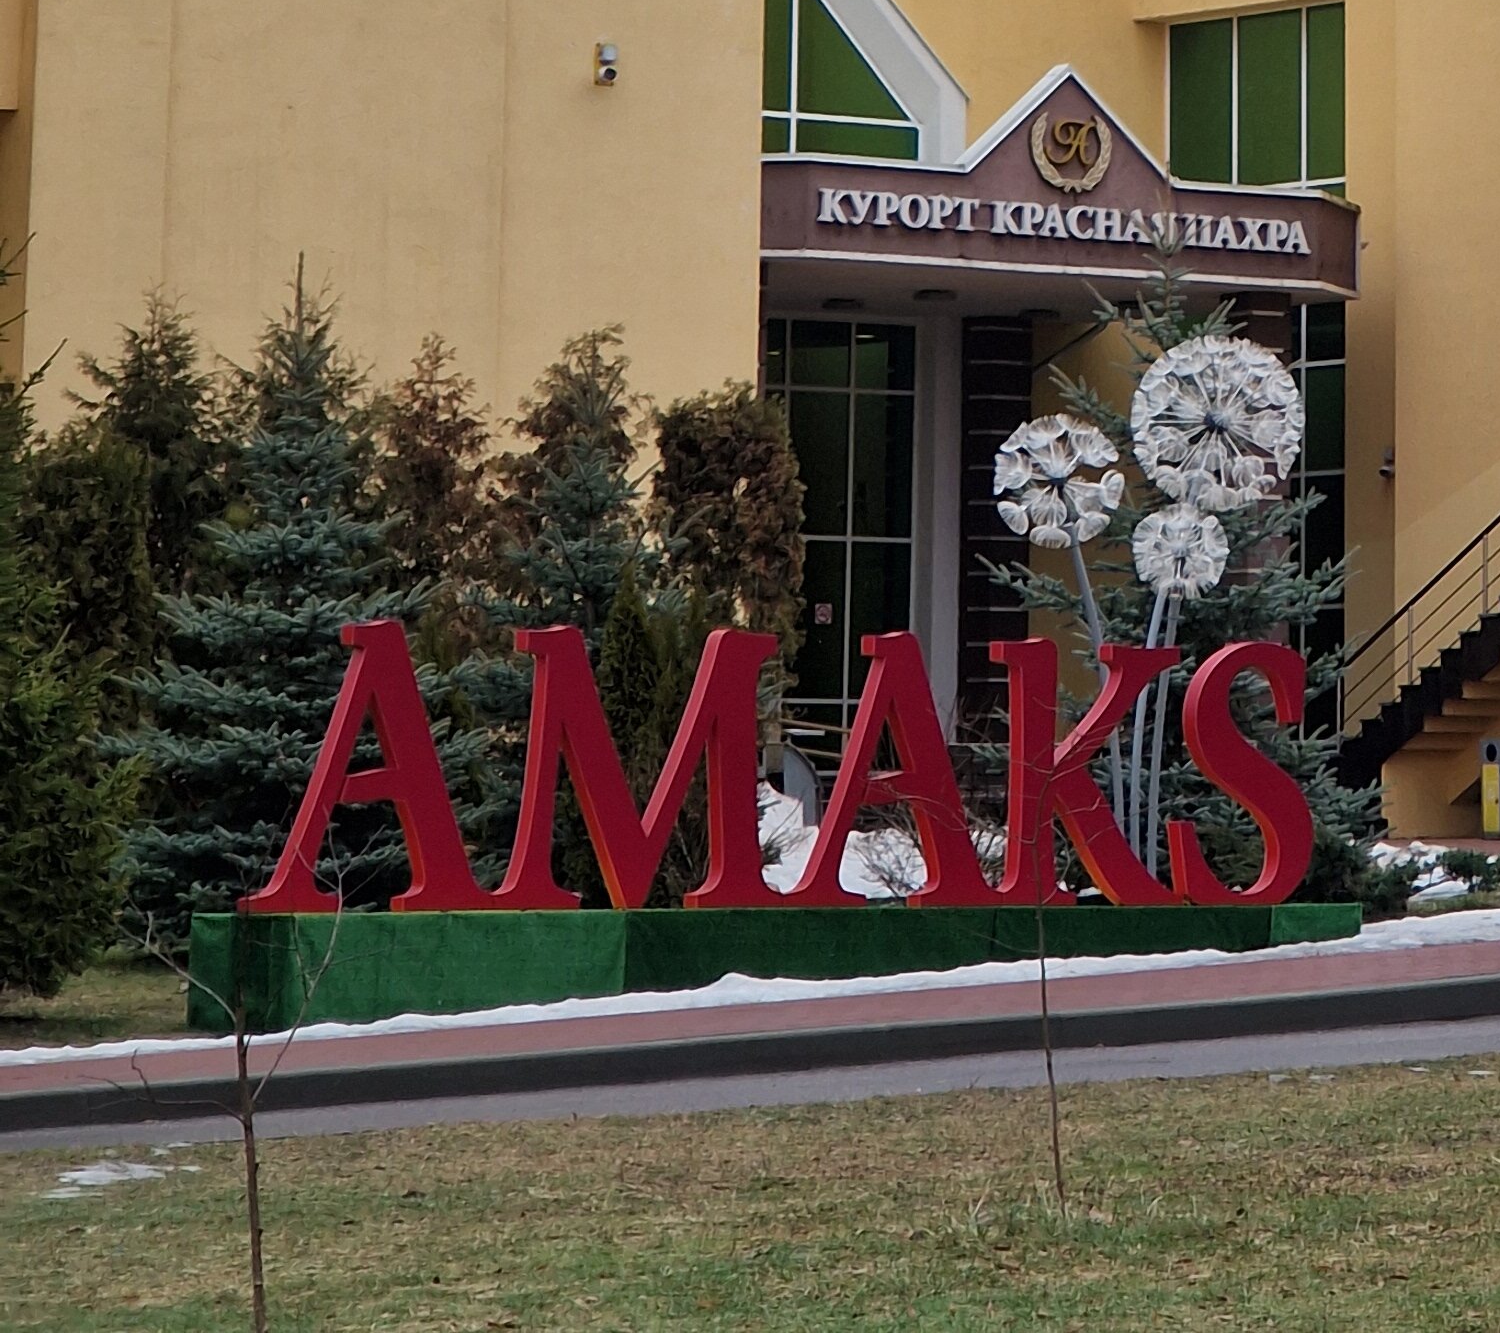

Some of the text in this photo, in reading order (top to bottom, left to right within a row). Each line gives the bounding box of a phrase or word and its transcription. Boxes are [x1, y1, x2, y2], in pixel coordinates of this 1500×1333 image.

[817, 187, 1312, 255] КУРОРТ КРАСНАЯ ПАХРА
[236, 619, 1314, 912] AMAKS
